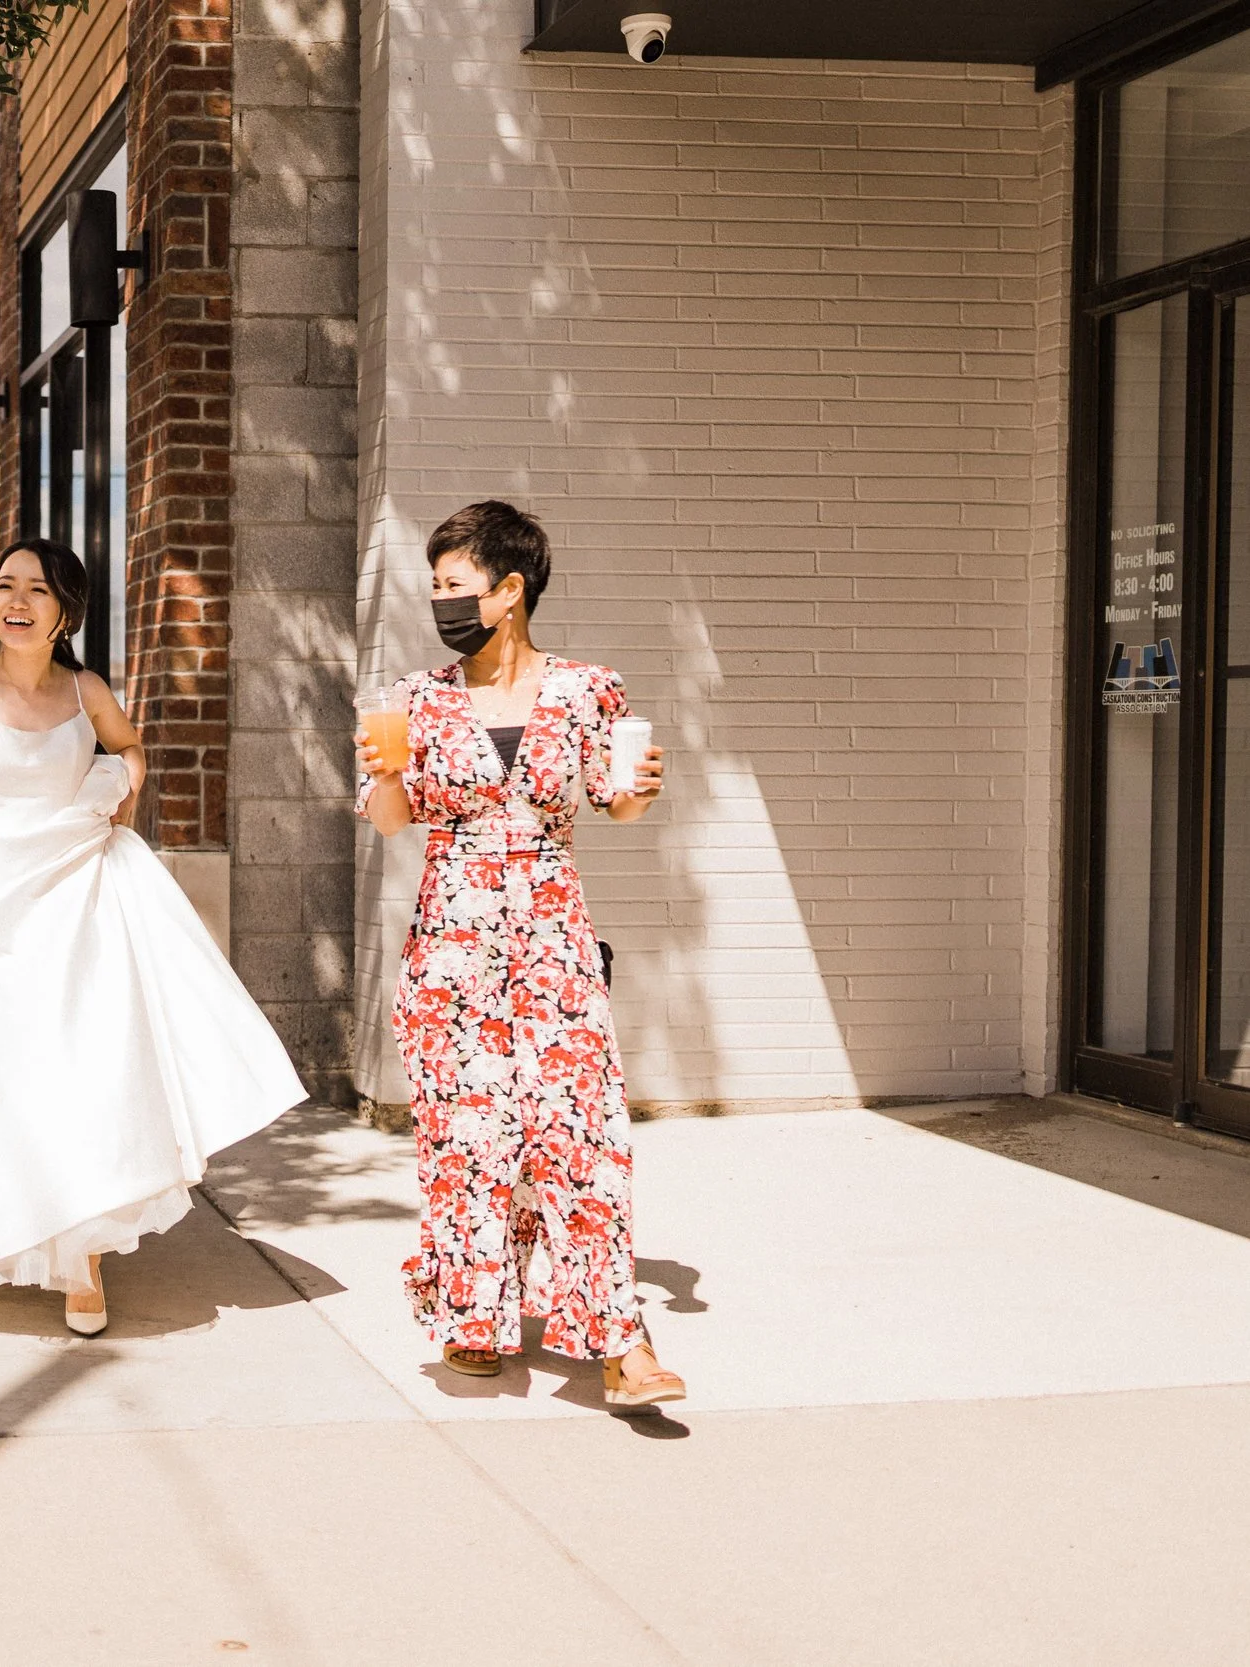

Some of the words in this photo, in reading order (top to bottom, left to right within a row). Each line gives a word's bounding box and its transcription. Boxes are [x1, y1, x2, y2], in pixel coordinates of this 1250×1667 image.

[1111, 530, 1123, 540] NO
[1126, 523, 1175, 538] SOLICITING
[1114, 552, 1143, 570] OFFICE
[1146, 548, 1175, 567] HOURS
[1114, 577, 1138, 596] 8:30
[1148, 573, 1174, 593] 4:00
[1105, 605, 1141, 623] MONDAY
[1151, 601, 1182, 620] FRIDAY
[1103, 693, 1136, 704] SASKATOON
[1137, 692, 1181, 703] CONSTRUCTION
[1116, 703, 1167, 712] ASSOCIATION
